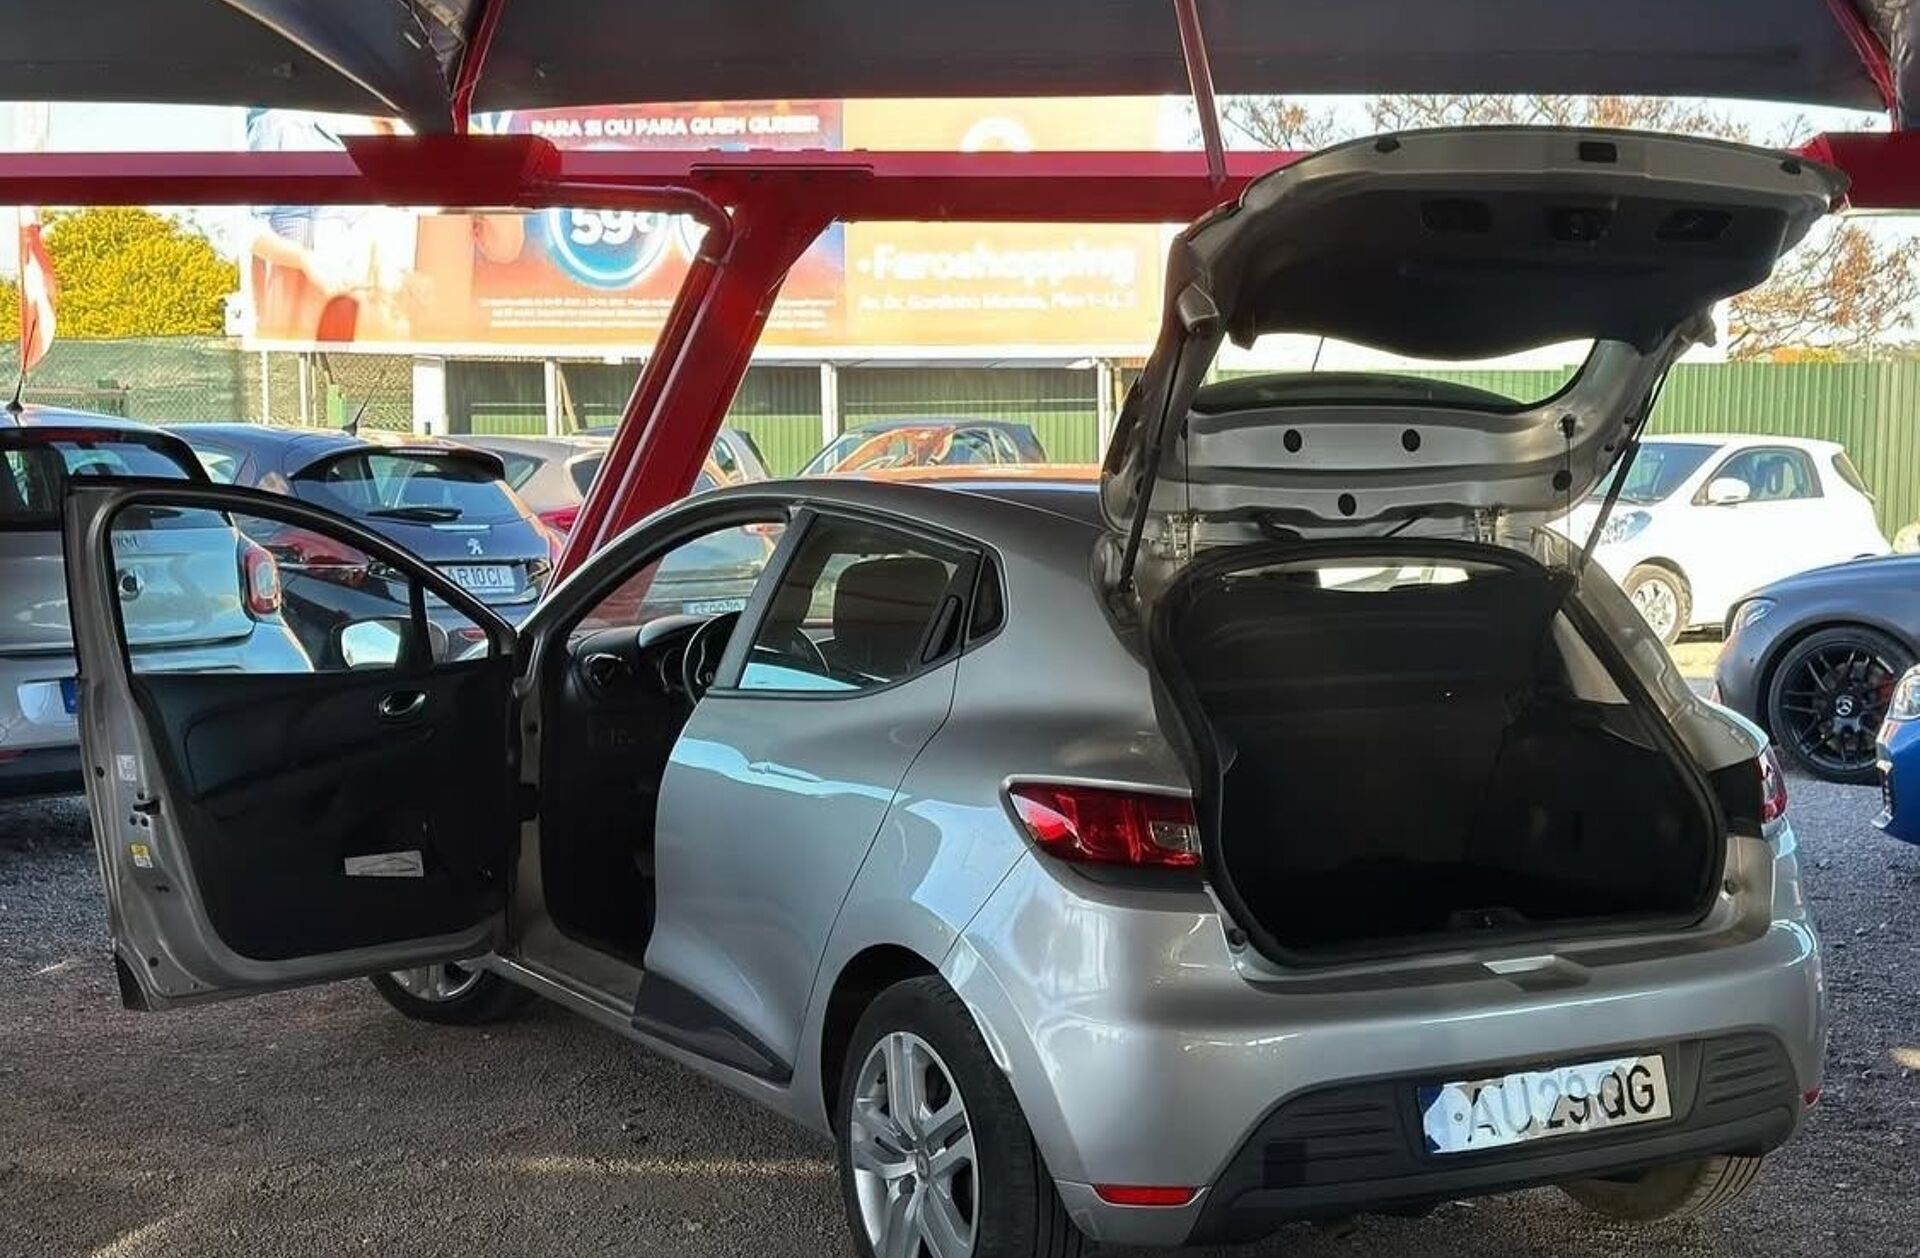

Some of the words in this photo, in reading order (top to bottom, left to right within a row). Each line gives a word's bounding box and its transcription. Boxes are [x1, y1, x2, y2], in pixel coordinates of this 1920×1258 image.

[531, 119, 582, 137] PARA
[585, 119, 602, 136] SI
[604, 118, 633, 136] OU
[635, 117, 688, 136] PARA
[690, 116, 746, 135] QUEM
[748, 114, 820, 133] QUISER
[873, 240, 1136, 287] Faroshopping
